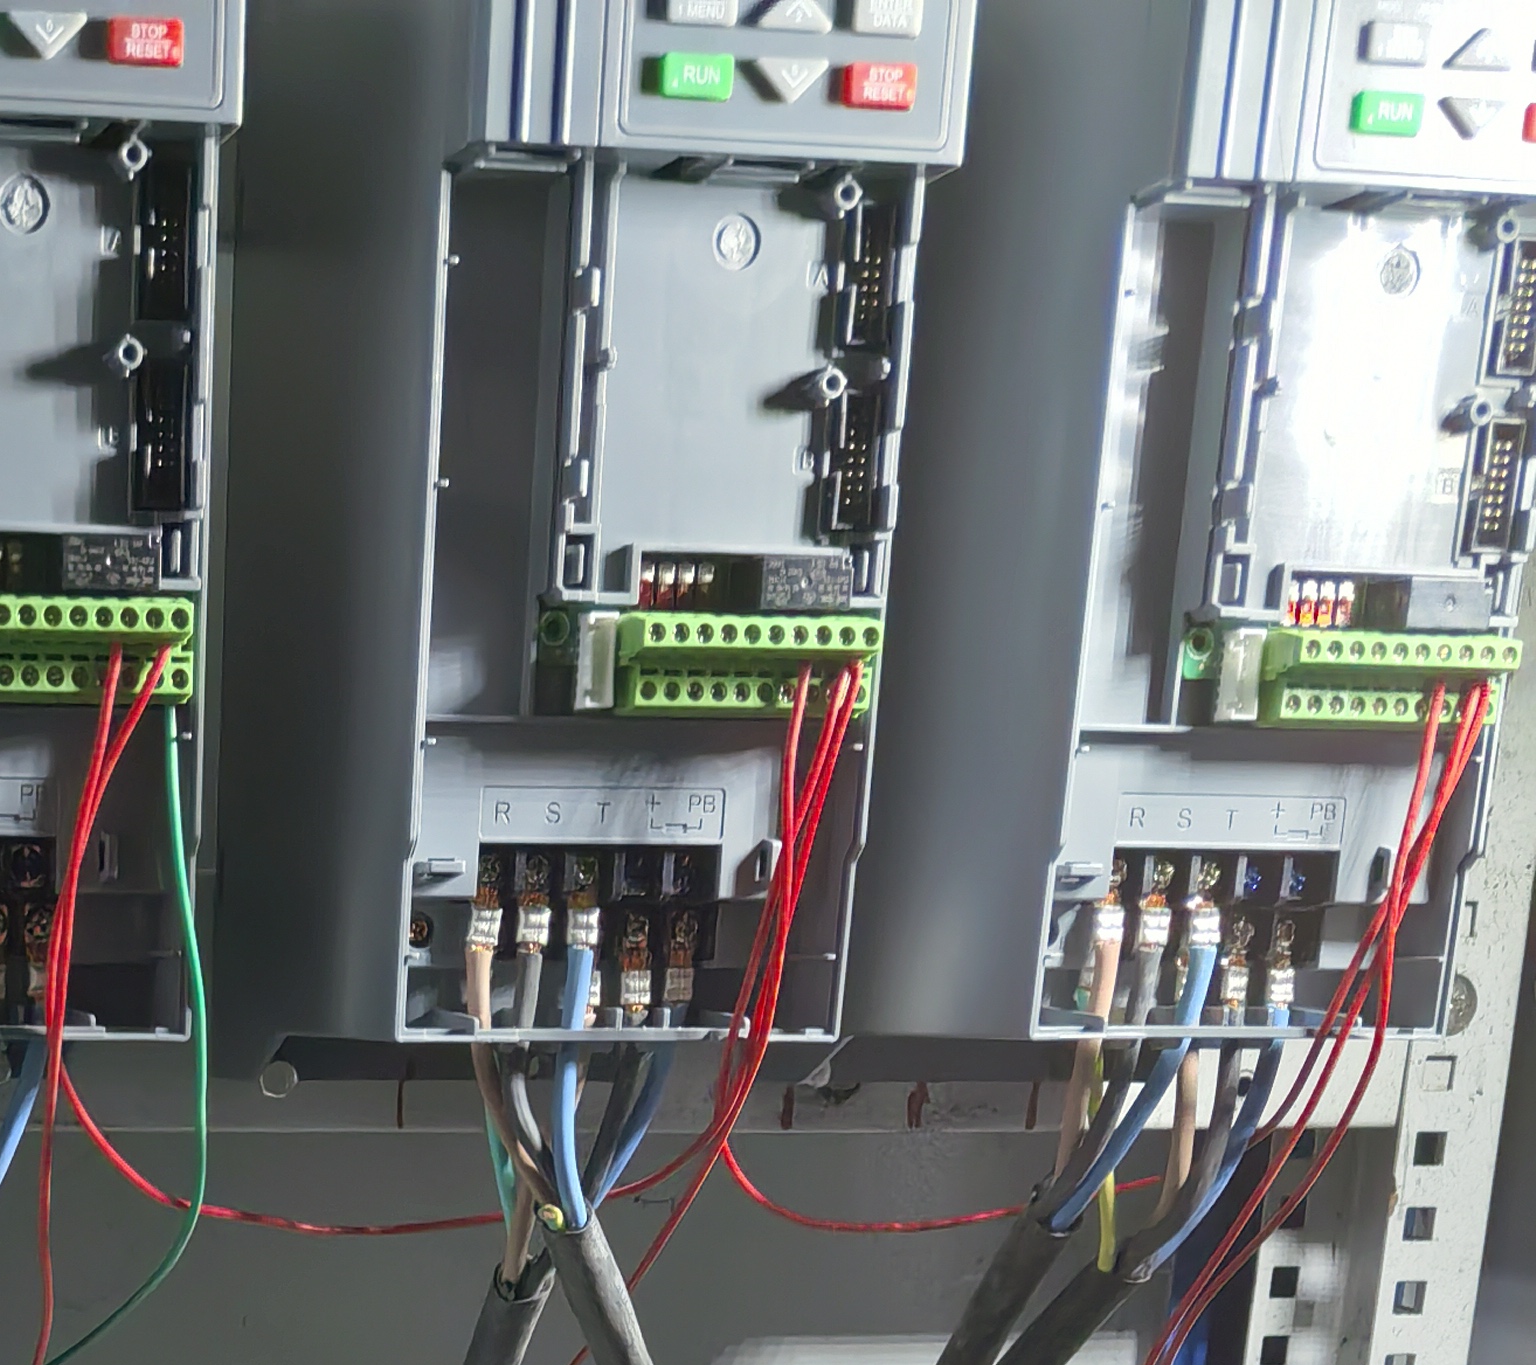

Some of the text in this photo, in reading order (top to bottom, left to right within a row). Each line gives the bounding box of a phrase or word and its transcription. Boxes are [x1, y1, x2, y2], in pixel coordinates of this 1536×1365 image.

[131, 23, 168, 40] STOP
[682, 65, 721, 85] RUN
[869, 67, 904, 82] STOP
[1377, 100, 1414, 121] RUN
[493, 801, 512, 825] R
[545, 802, 562, 824] S
[596, 801, 612, 825] T
[687, 794, 717, 814] PB
[1129, 806, 1146, 829] R
[1177, 809, 1193, 830] S
[1225, 808, 1240, 831] T
[1310, 802, 1337, 822] PB
